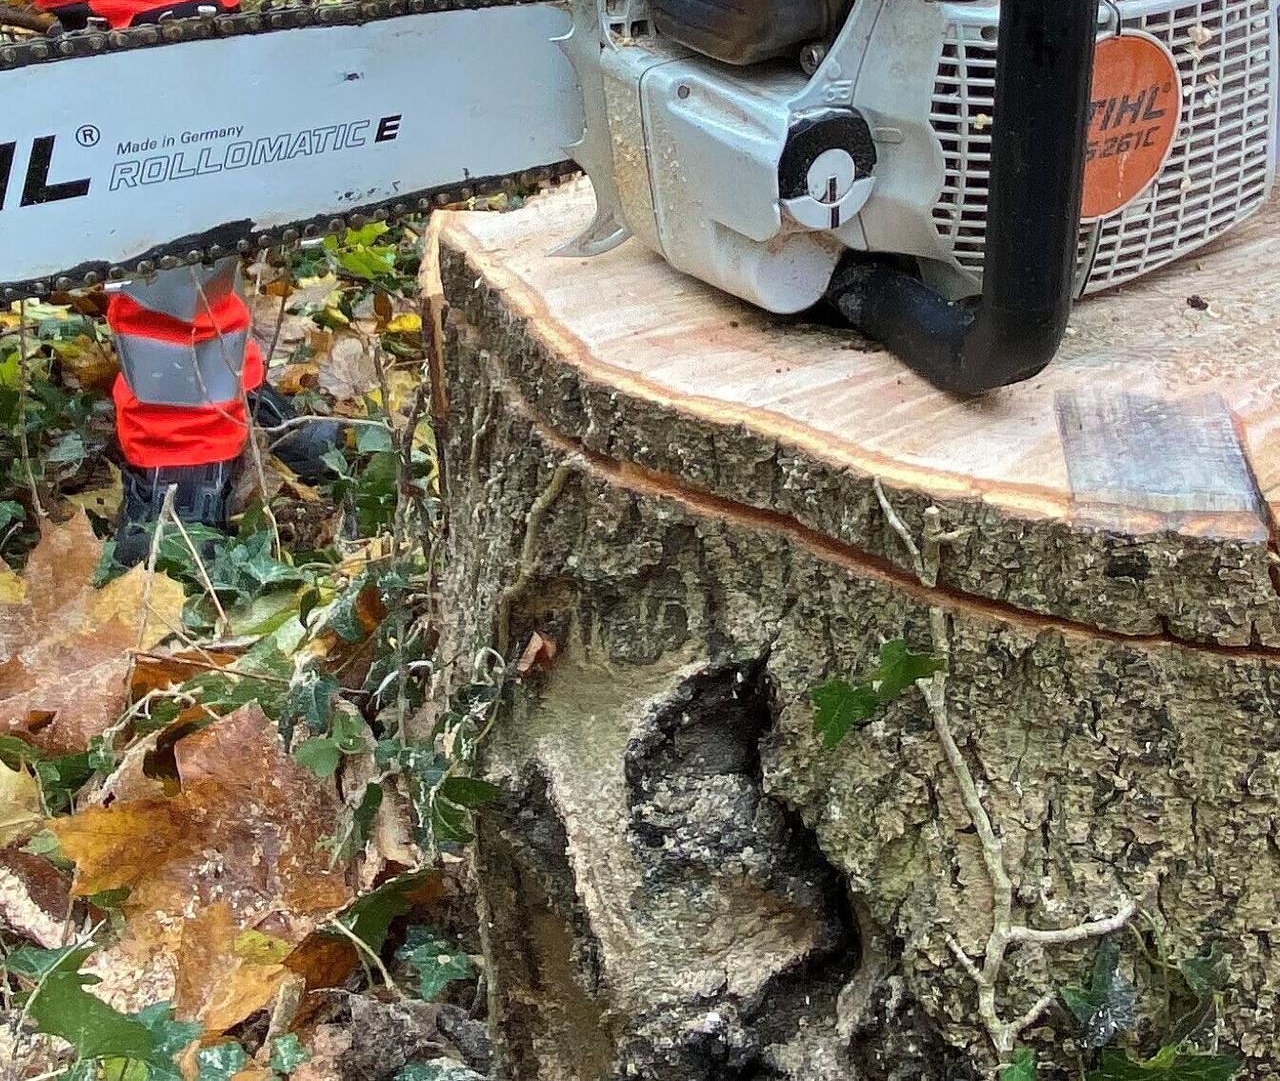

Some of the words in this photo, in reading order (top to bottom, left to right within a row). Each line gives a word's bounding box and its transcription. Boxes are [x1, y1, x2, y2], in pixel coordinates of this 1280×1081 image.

[1089, 84, 1168, 131] TIHL
[108, 120, 371, 192] ROLLOMATIC
[374, 115, 402, 144] E
[116, 138, 158, 156] Made
[162, 135, 175, 149] in
[180, 125, 244, 145] Germany
